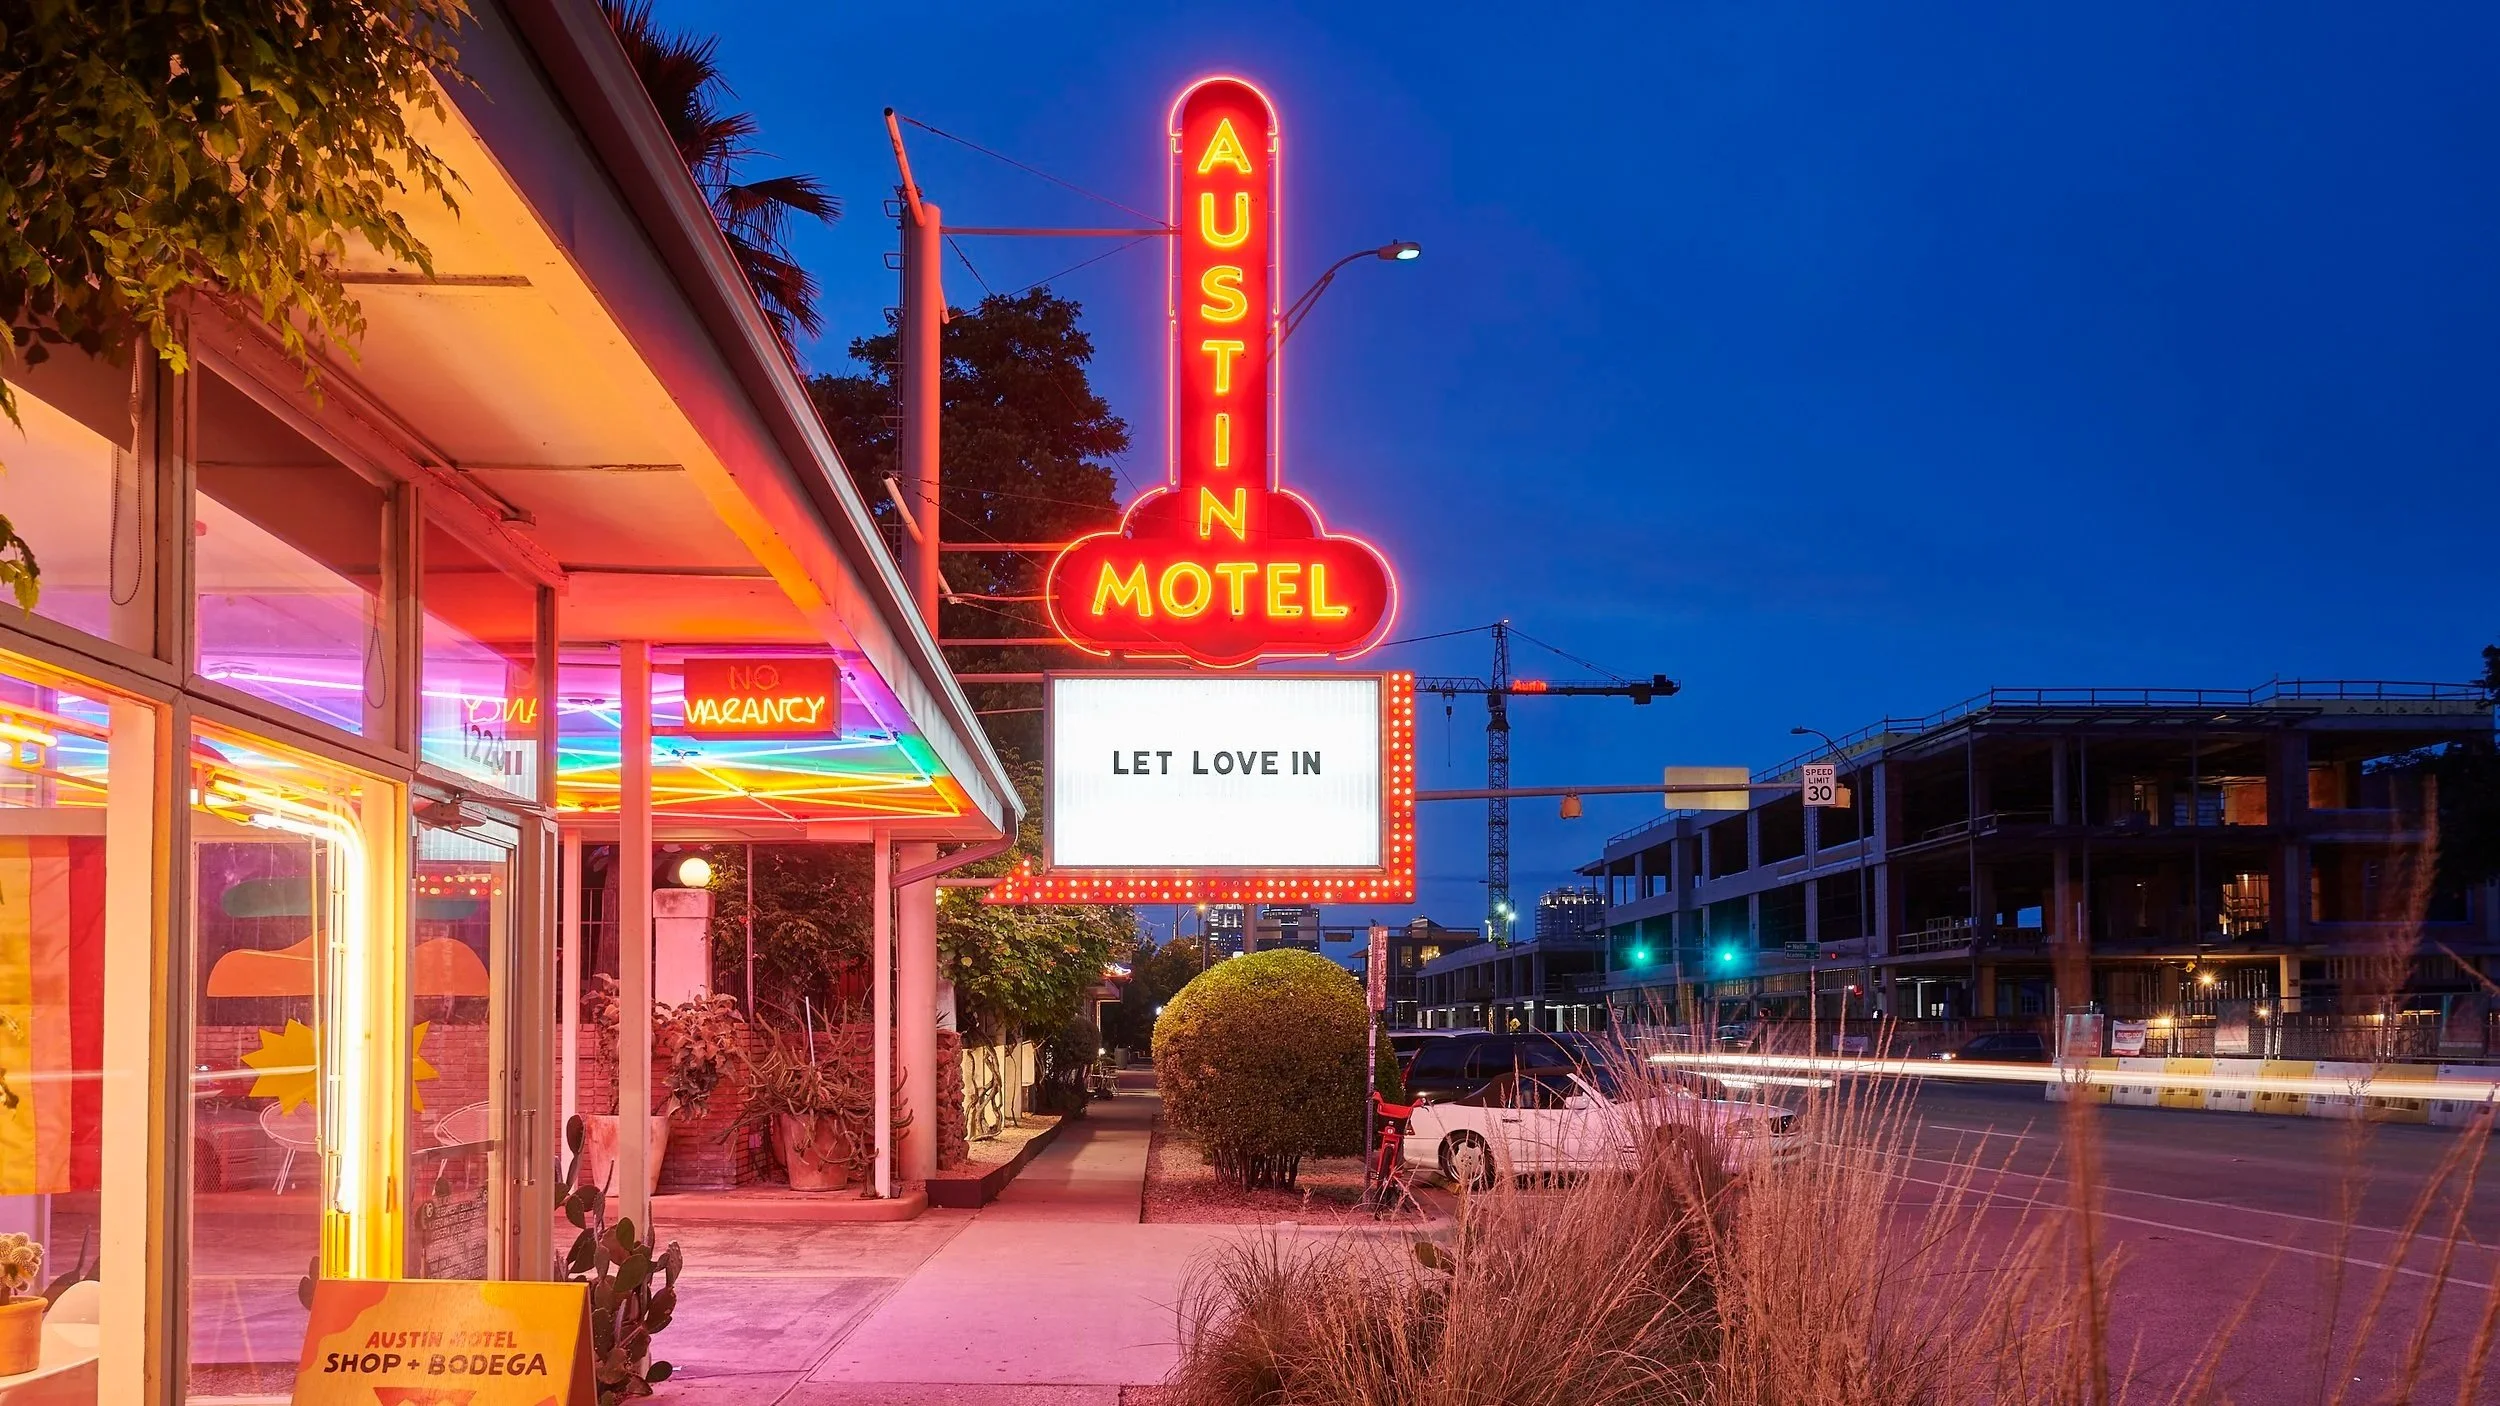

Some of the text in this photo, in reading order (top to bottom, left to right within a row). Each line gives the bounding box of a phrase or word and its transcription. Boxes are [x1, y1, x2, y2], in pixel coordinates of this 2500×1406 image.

[1197, 117, 1252, 542] AUSTIN
[1091, 561, 1349, 618] MOTEL
[729, 664, 779, 691] NO
[684, 695, 825, 725] VACANCY
[464, 722, 505, 772] 1220
[1113, 750, 1321, 776] LET LOVE IN
[1805, 768, 1833, 776] SPEED
[1807, 785, 1832, 801] 30
[365, 1330, 443, 1349] AUSTIN
[323, 1352, 401, 1374] SHOP
[427, 1353, 547, 1376] BODEGA
